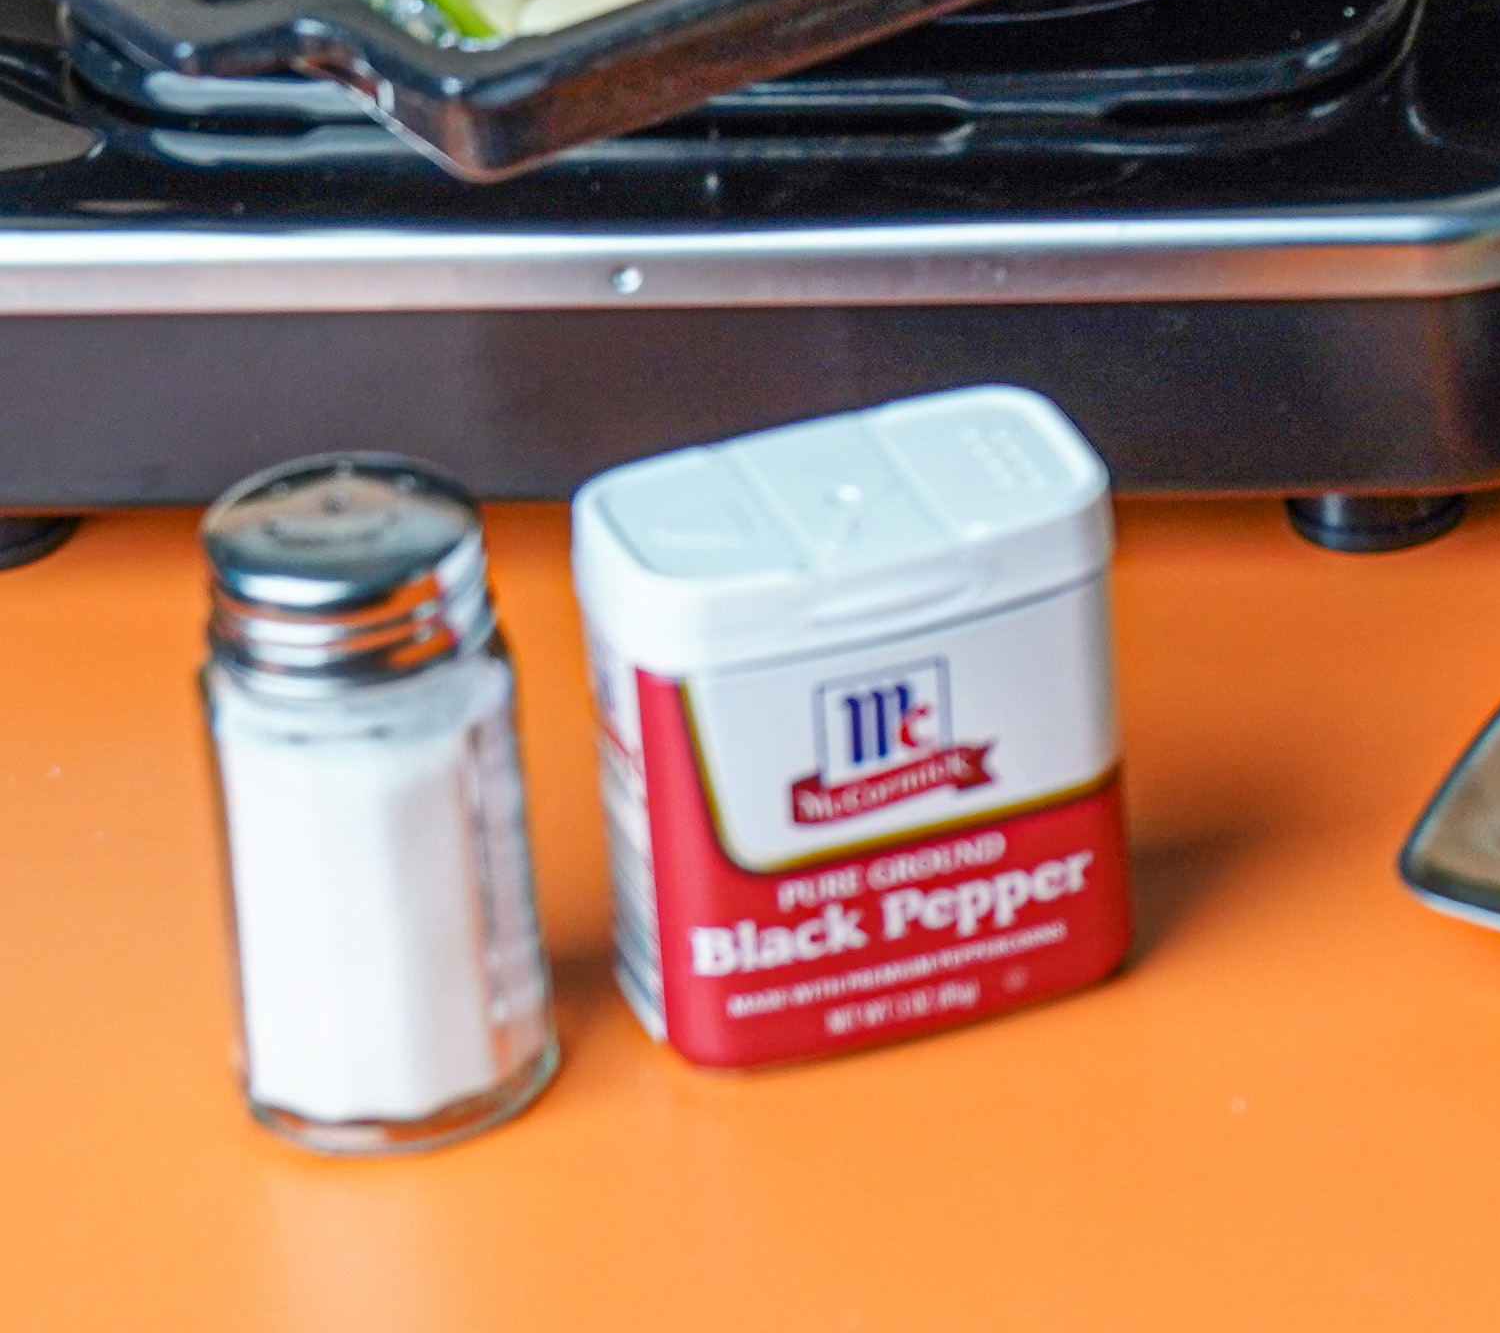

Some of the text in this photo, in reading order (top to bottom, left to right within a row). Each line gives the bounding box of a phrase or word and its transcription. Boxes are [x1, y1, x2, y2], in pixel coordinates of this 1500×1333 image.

[691, 849, 1094, 978] Black Pepper
[777, 831, 1007, 912] PURE GROUND
